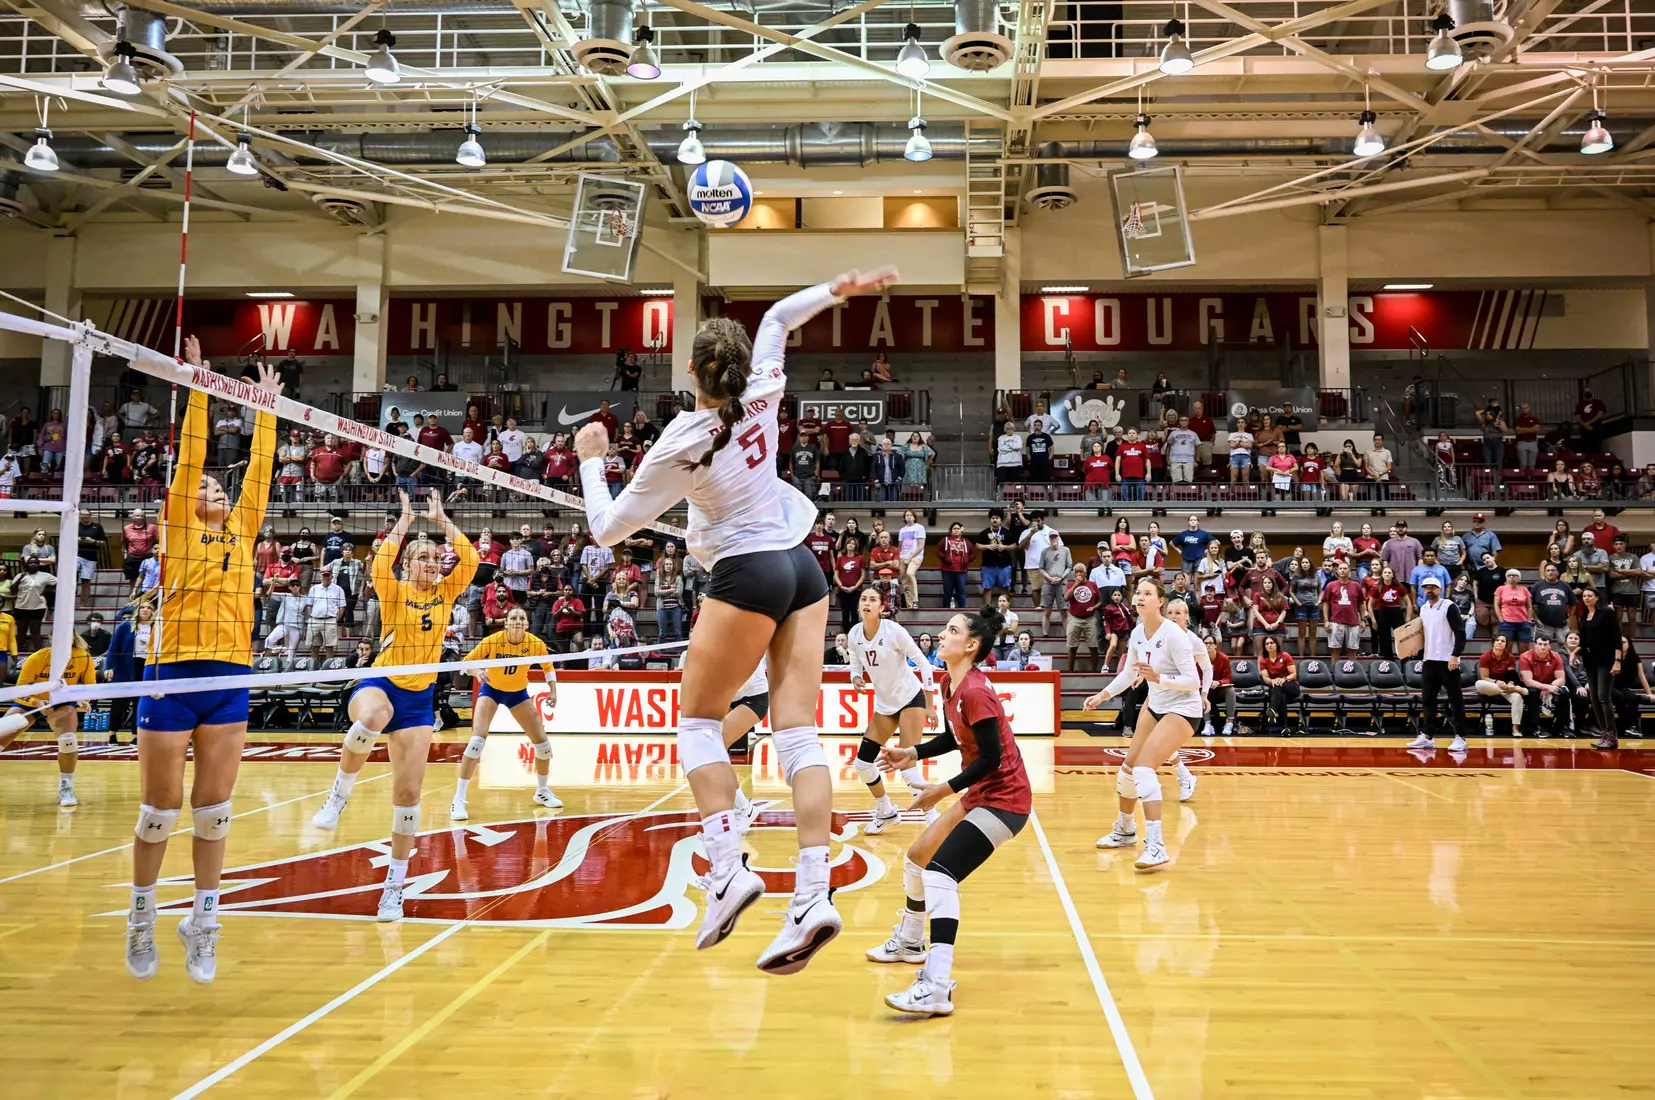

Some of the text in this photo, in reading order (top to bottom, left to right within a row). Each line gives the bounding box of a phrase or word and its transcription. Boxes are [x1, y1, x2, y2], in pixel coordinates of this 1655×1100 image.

[697, 188, 733, 199] molten
[701, 201, 730, 213] NCAA
[786, 300, 986, 348] TATE
[191, 366, 277, 410] WASHINGTON STATE
[443, 409, 463, 417] Union
[1293, 405, 1313, 414] Union
[337, 417, 396, 449] WASHINGTON STATE
[735, 423, 768, 470] 5
[221, 552, 231, 572] 1
[421, 613, 433, 632] 5
[865, 650, 879, 667] 12
[1145, 651, 1152, 665] 7
[503, 664, 518, 675] 10
